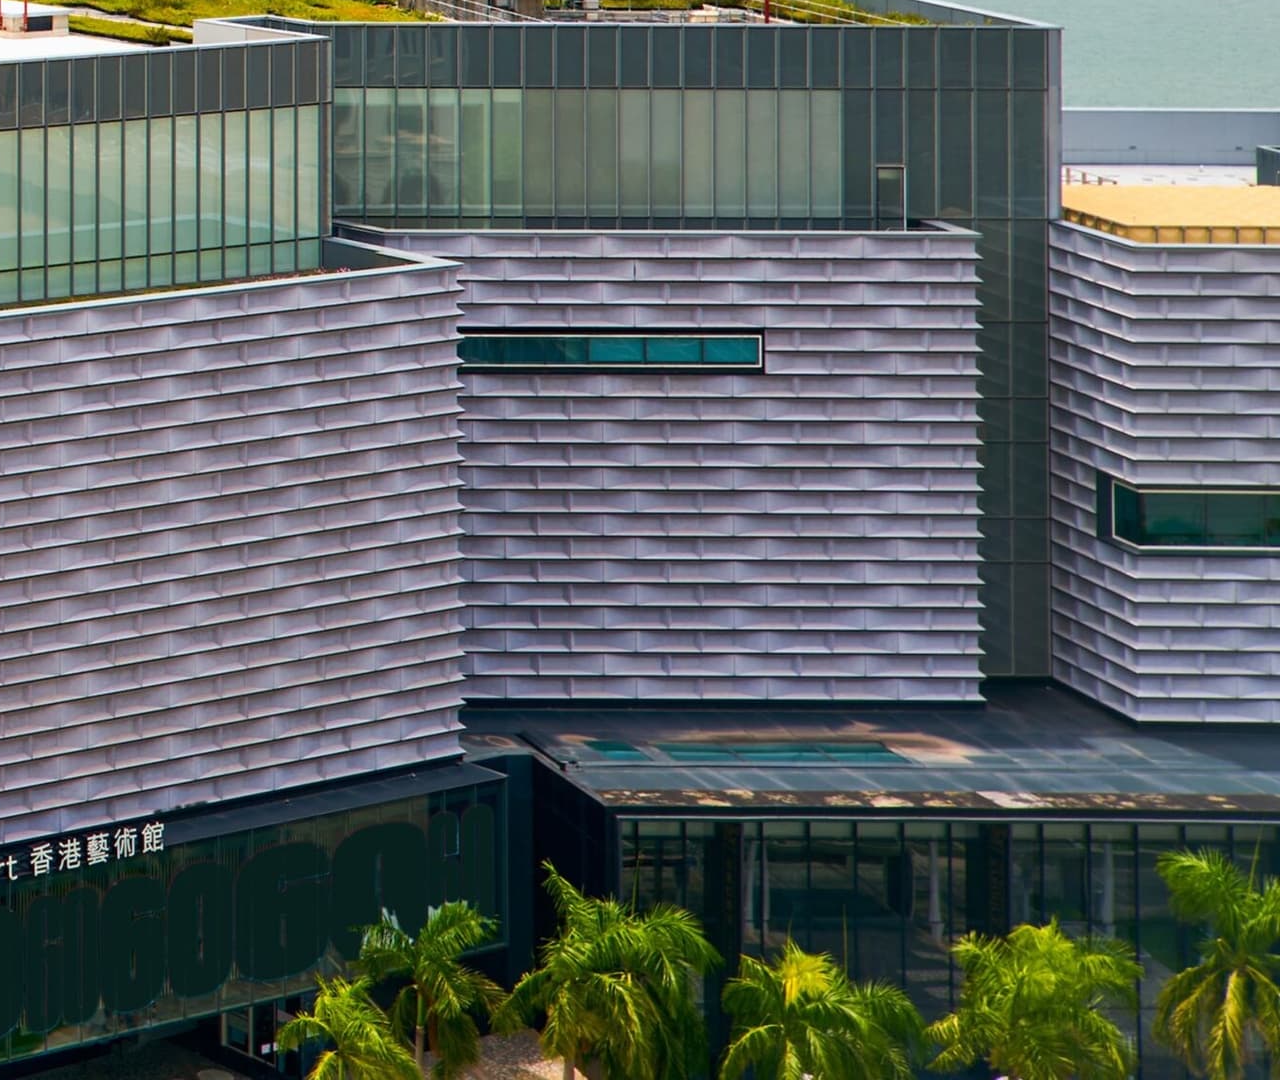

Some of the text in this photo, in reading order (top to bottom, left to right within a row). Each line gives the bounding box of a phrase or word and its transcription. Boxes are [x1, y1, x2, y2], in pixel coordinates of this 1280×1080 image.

[29, 821, 165, 878] 香港藝術館
